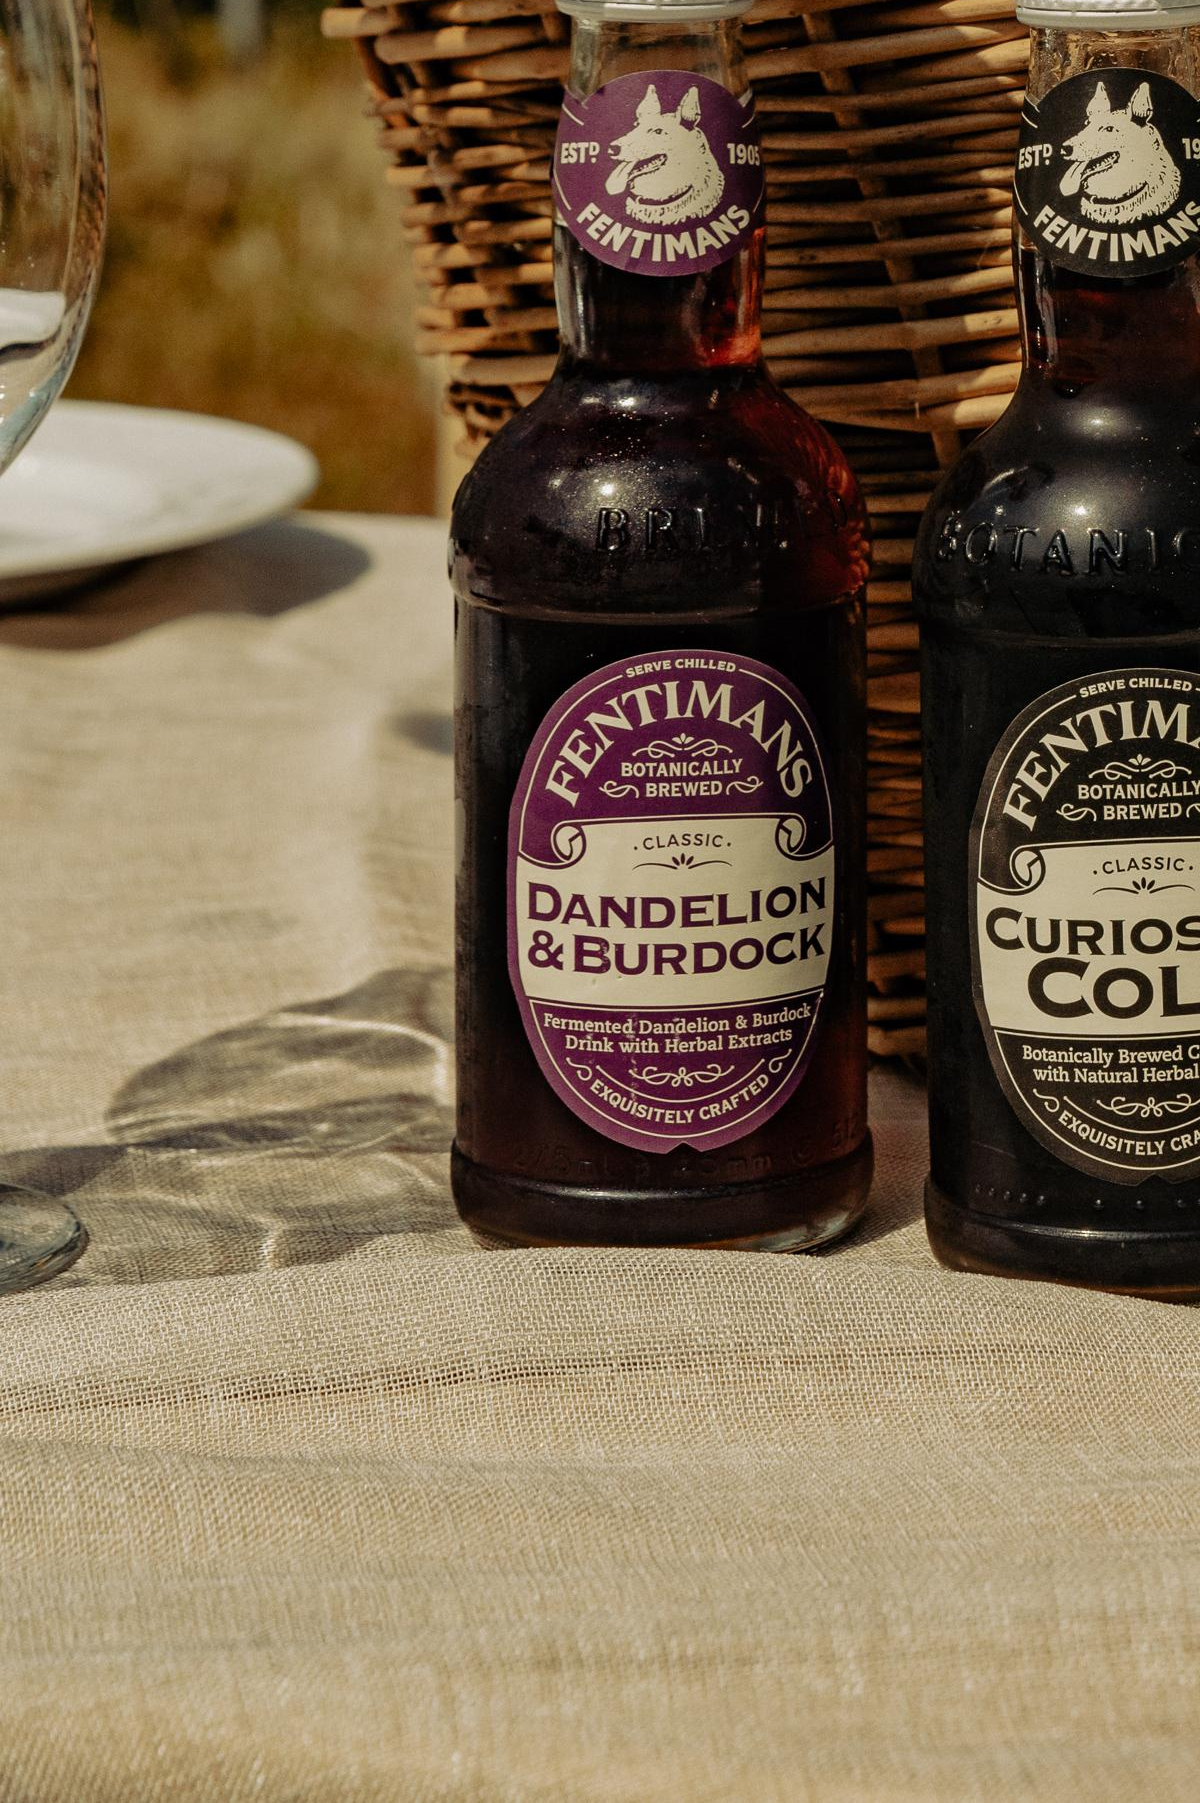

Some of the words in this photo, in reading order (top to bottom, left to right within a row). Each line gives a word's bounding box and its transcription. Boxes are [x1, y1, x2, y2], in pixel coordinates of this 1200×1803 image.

[727, 143, 760, 167] 1905
[576, 201, 751, 262] FENTIMANS
[625, 659, 673, 677] SERVE
[674, 658, 737, 673] CHILLED
[1079, 678, 1126, 697] SERVE
[1129, 677, 1193, 692] CHILLED
[544, 679, 813, 808] FENTIMANS
[620, 758, 743, 777] BOTANICALLY
[645, 780, 724, 798] BREWED
[1102, 802, 1183, 821] BREWED
[526, 876, 826, 930] DANDELION
[543, 1012, 633, 1035] Fermented
[639, 1014, 731, 1035] Dandelion
[735, 1014, 749, 1031] &
[752, 1002, 812, 1029] Burdock
[565, 1034, 615, 1054] Drink
[618, 1035, 661, 1055] with
[664, 1032, 724, 1054] Herbal
[728, 1026, 793, 1050] Extracts
[1022, 1044, 1114, 1068] Botanically
[1117, 1044, 1184, 1066] Brewed
[1033, 1064, 1070, 1083] with
[1073, 1064, 1139, 1084] Natural
[1142, 1060, 1200, 1084] Herbal
[589, 1080, 695, 1125] EXQUISITELY
[698, 1073, 771, 1122] CRAFTED
[1057, 1109, 1166, 1156] EXQUISITELY
